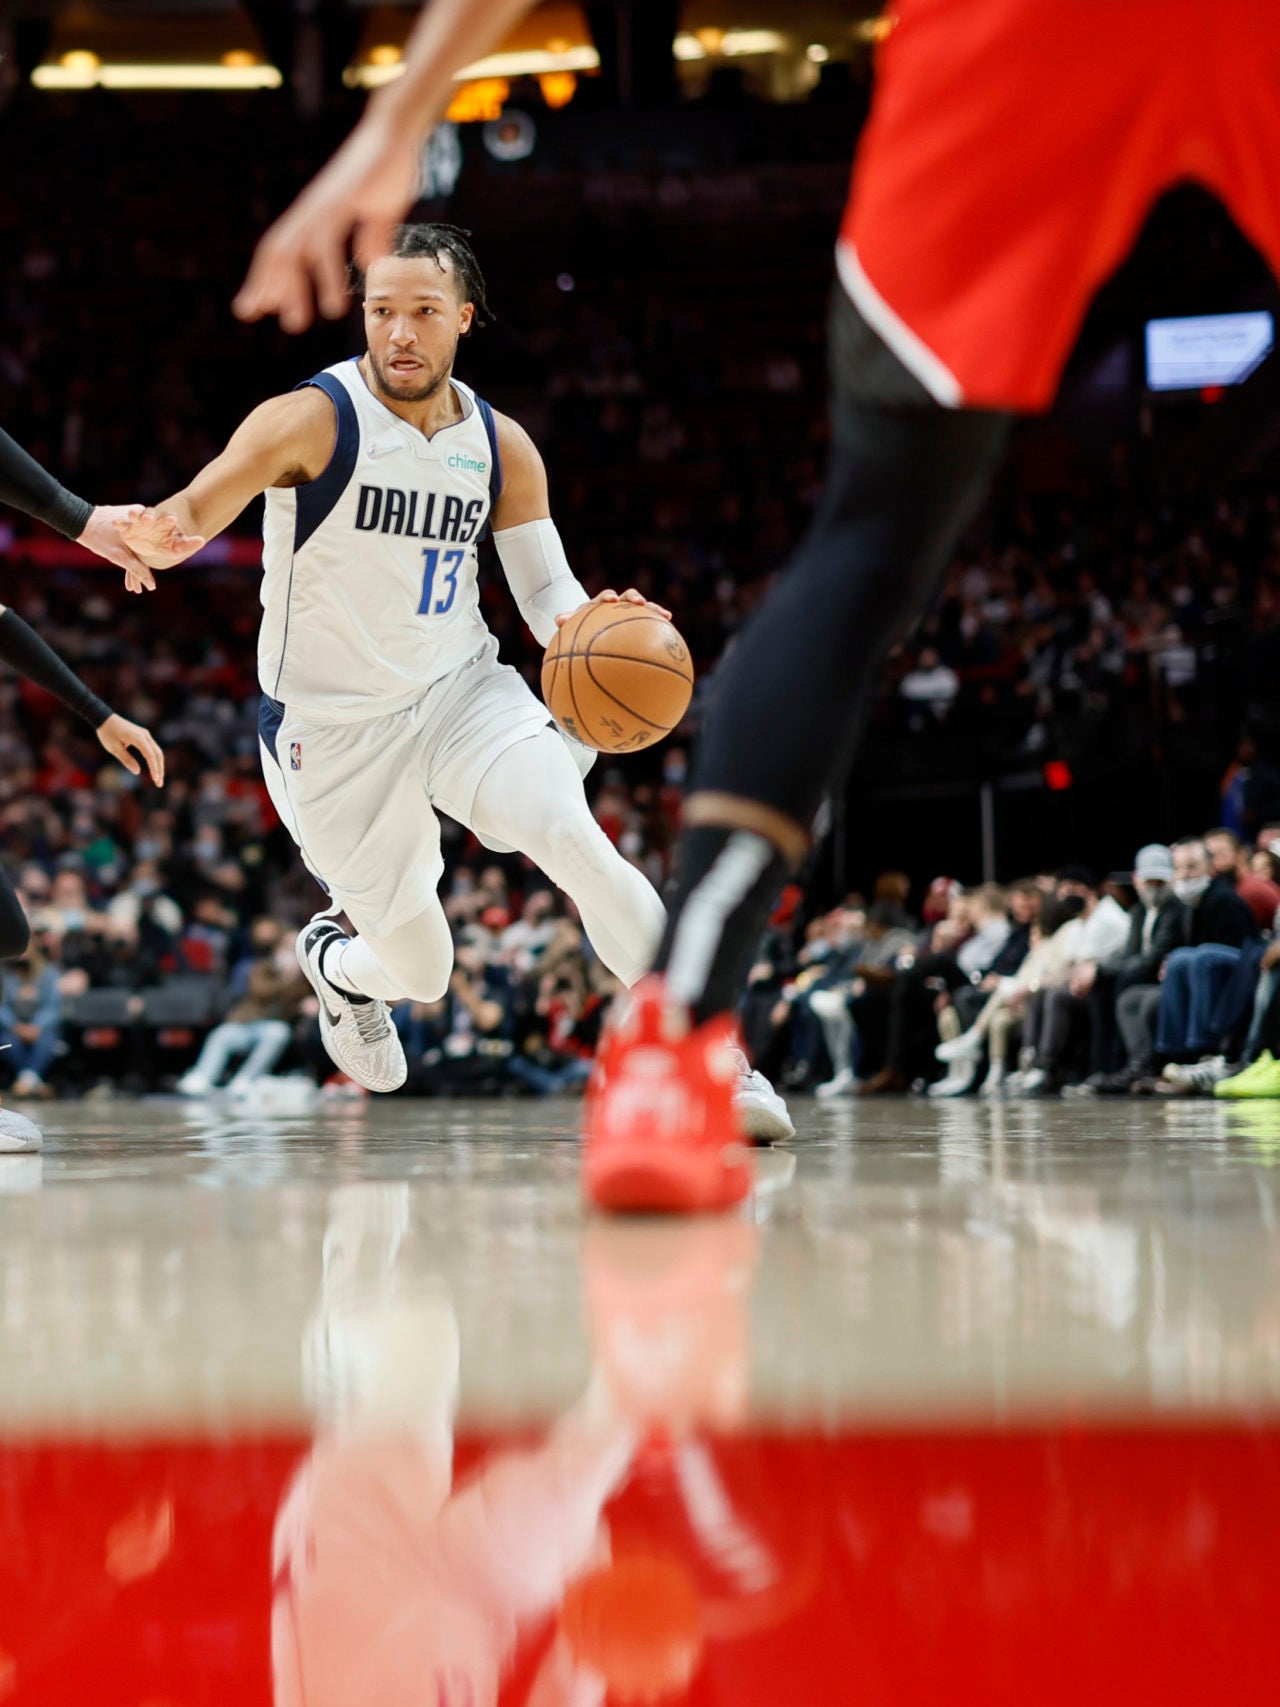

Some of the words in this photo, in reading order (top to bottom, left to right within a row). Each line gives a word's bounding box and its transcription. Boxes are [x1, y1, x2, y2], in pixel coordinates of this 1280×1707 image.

[447, 453, 486, 473] chime
[354, 484, 484, 543] DALLAS
[417, 547, 465, 615] 13
